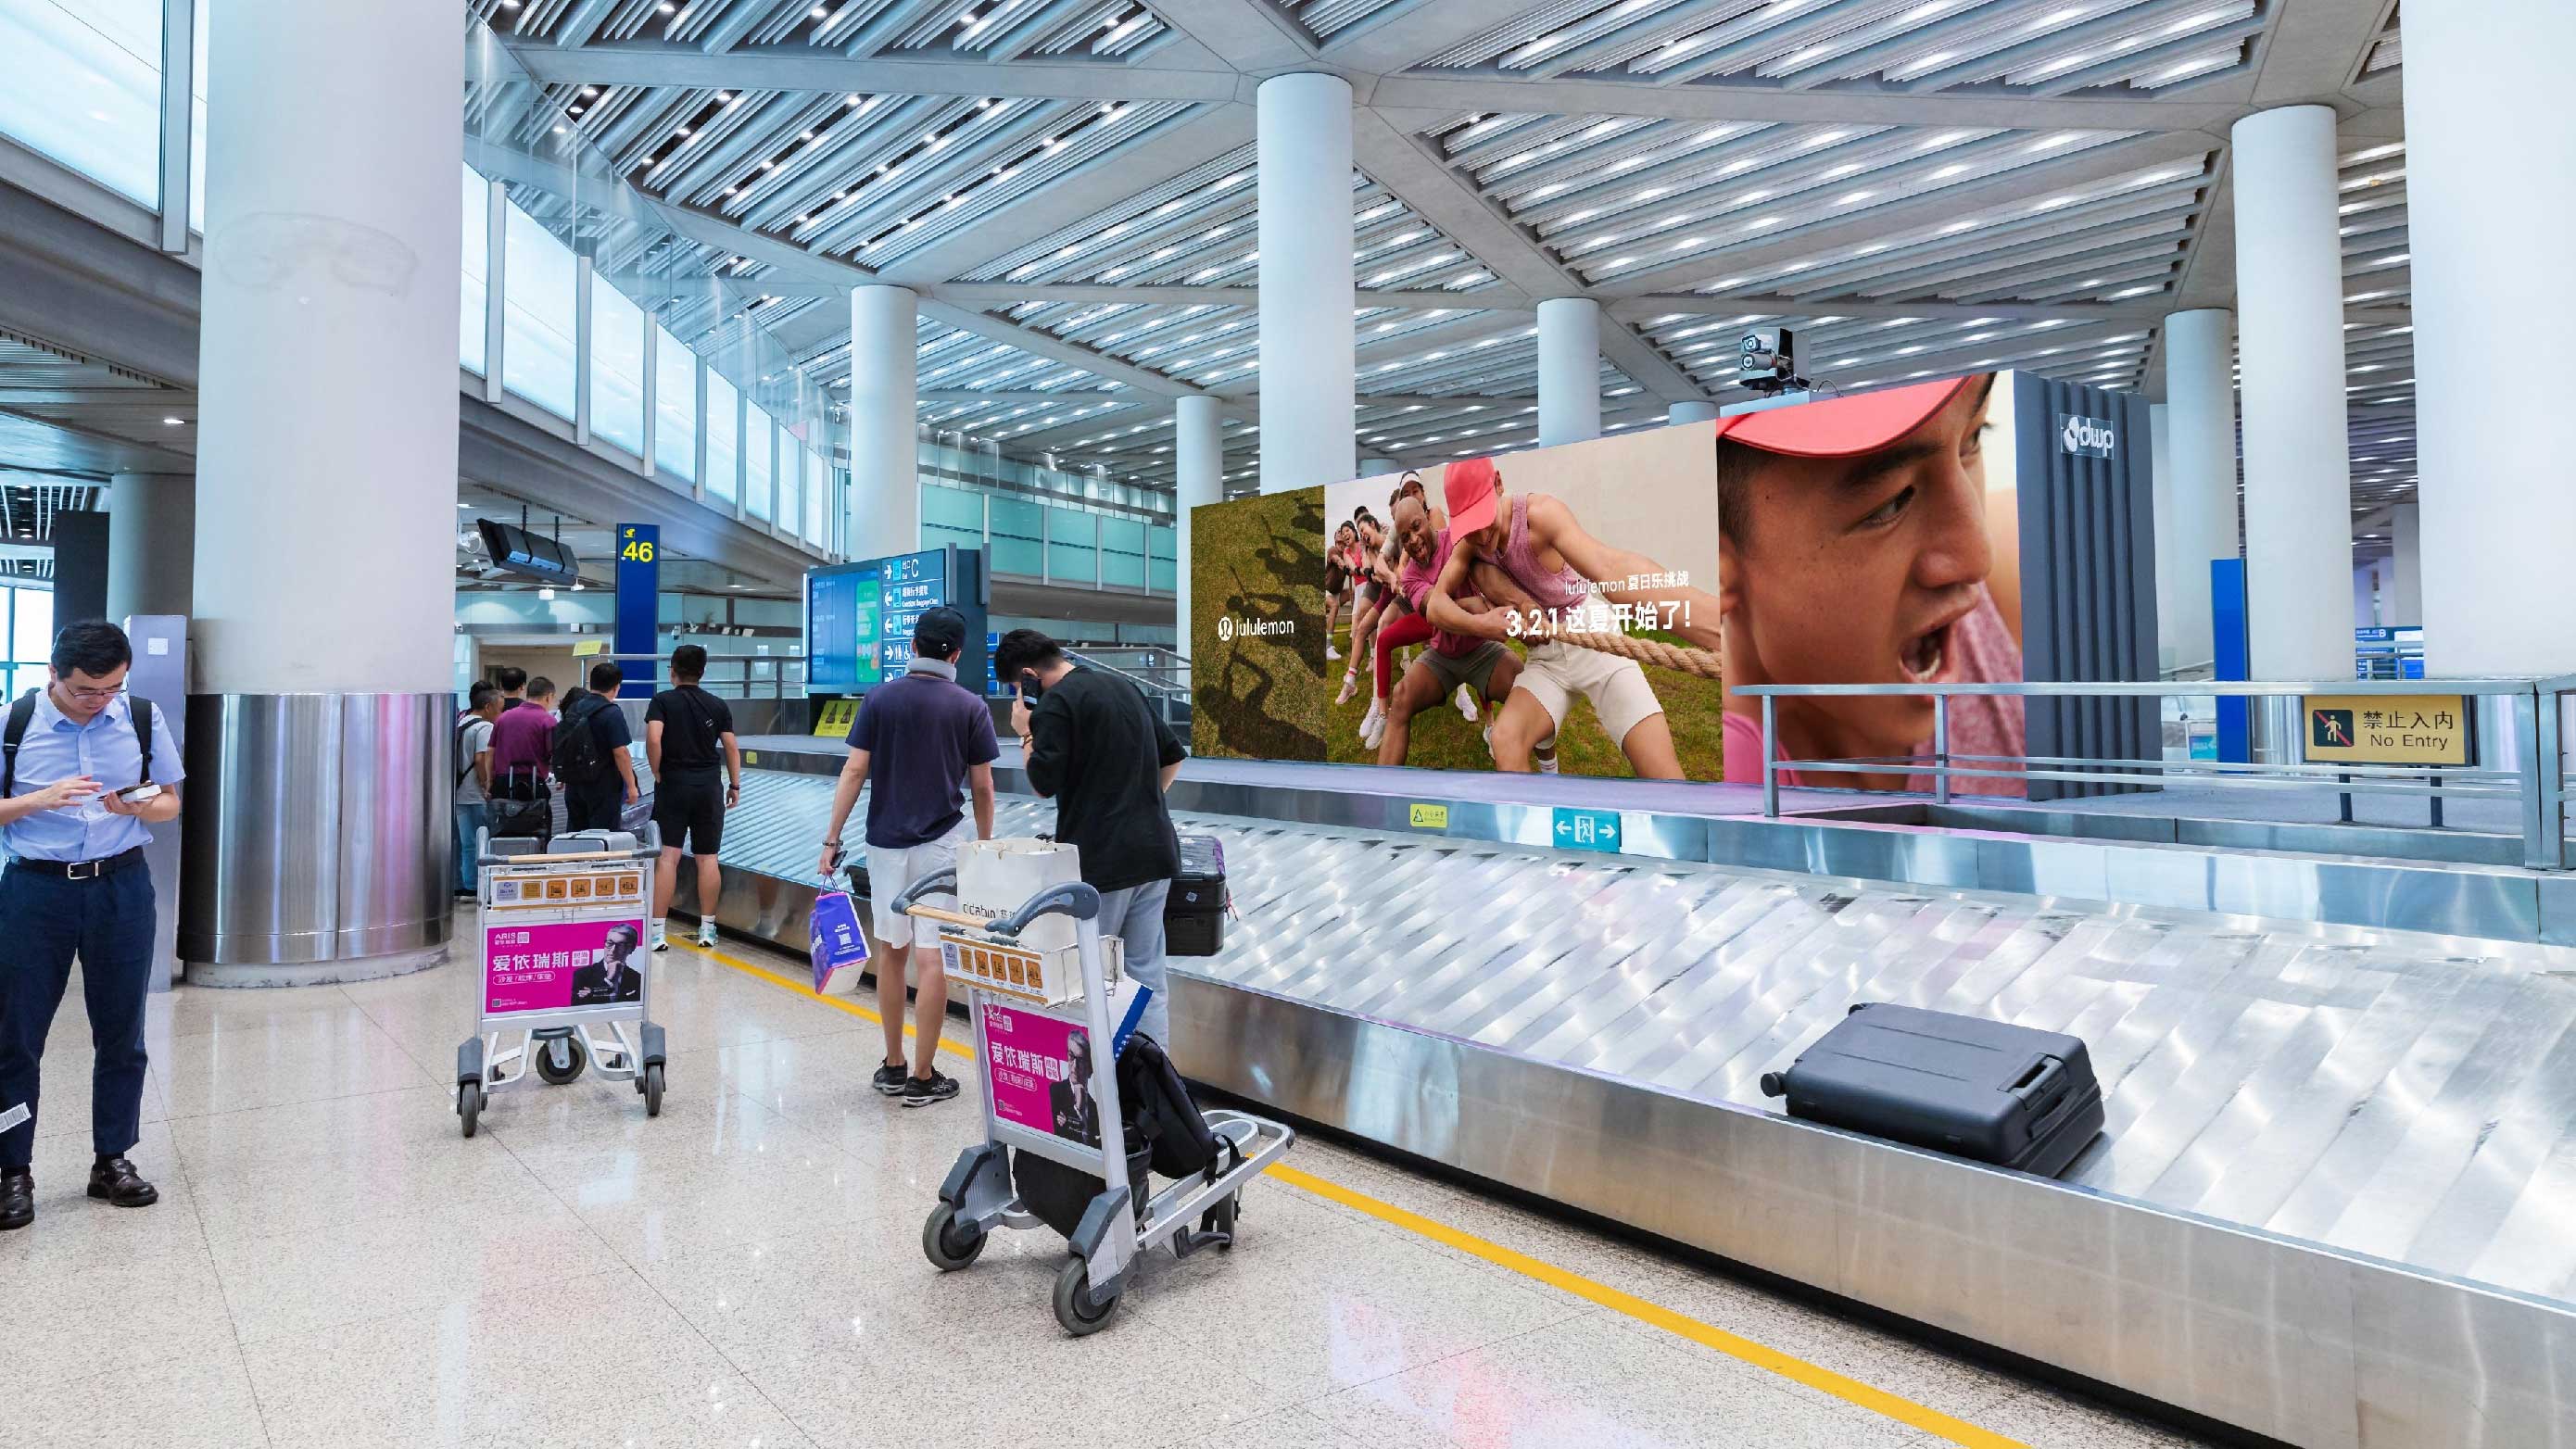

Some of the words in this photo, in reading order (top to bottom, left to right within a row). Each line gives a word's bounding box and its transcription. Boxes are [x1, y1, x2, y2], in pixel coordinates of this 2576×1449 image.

[2079, 418, 2115, 458] dwp
[624, 541, 653, 562] 46
[912, 559, 919, 578] C
[1565, 578, 1625, 596] lululemon
[1627, 571, 1689, 591] 夏日乐挑战
[1236, 617, 1294, 636] lululemon
[1506, 607, 1558, 639] 3,2,1
[2364, 711, 2454, 729] 禁止入内
[2371, 734, 2393, 747] No
[2403, 734, 2448, 750] Entry
[495, 932, 516, 940] ARIS
[492, 951, 570, 972] 爱依瑞斯
[991, 1041, 1044, 1077] 爱依瑞斯
